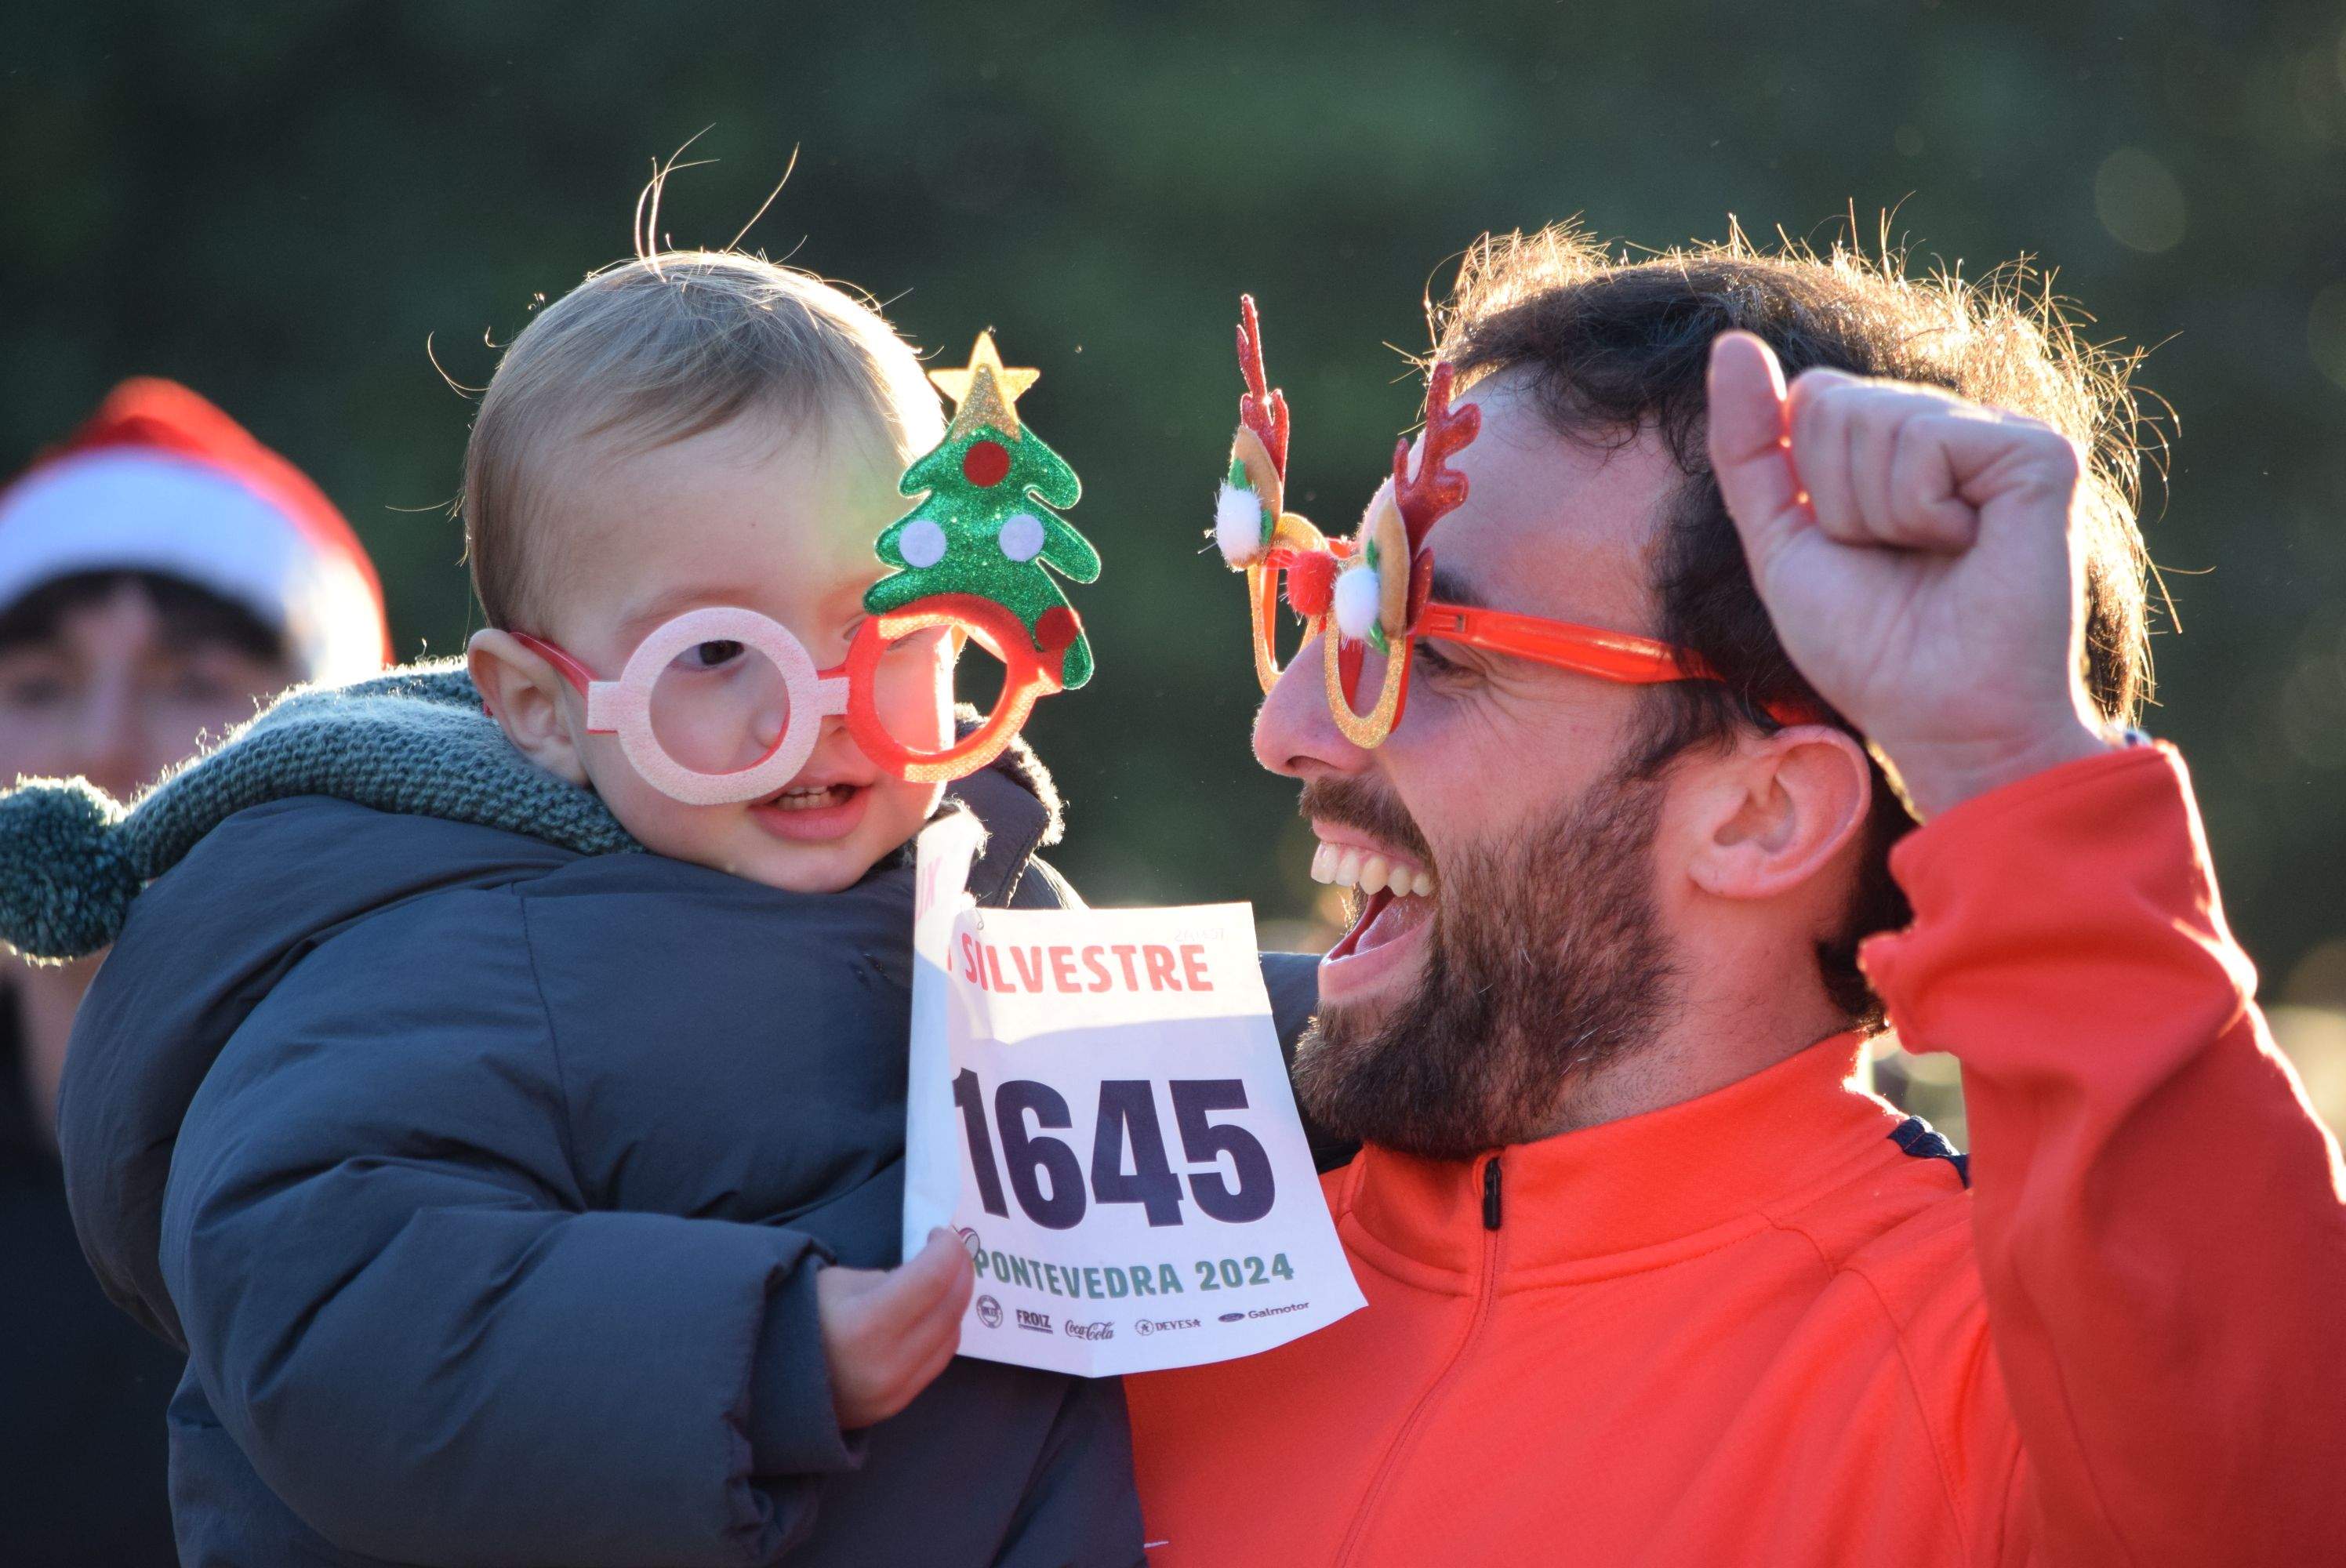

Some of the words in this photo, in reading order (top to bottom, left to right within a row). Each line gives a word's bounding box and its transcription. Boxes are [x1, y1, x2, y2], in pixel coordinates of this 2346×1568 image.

[961, 932, 1215, 993] SILVESTRE
[952, 1067, 1276, 1231] 1645
[975, 1248, 1184, 1299] PONTEVEDRA
[1195, 1252, 1295, 1291] 2024
[1016, 1309, 1051, 1329] FROIZ
[1248, 1301, 1310, 1319] Galmotor
[1065, 1319, 1115, 1341] Coca-Cola
